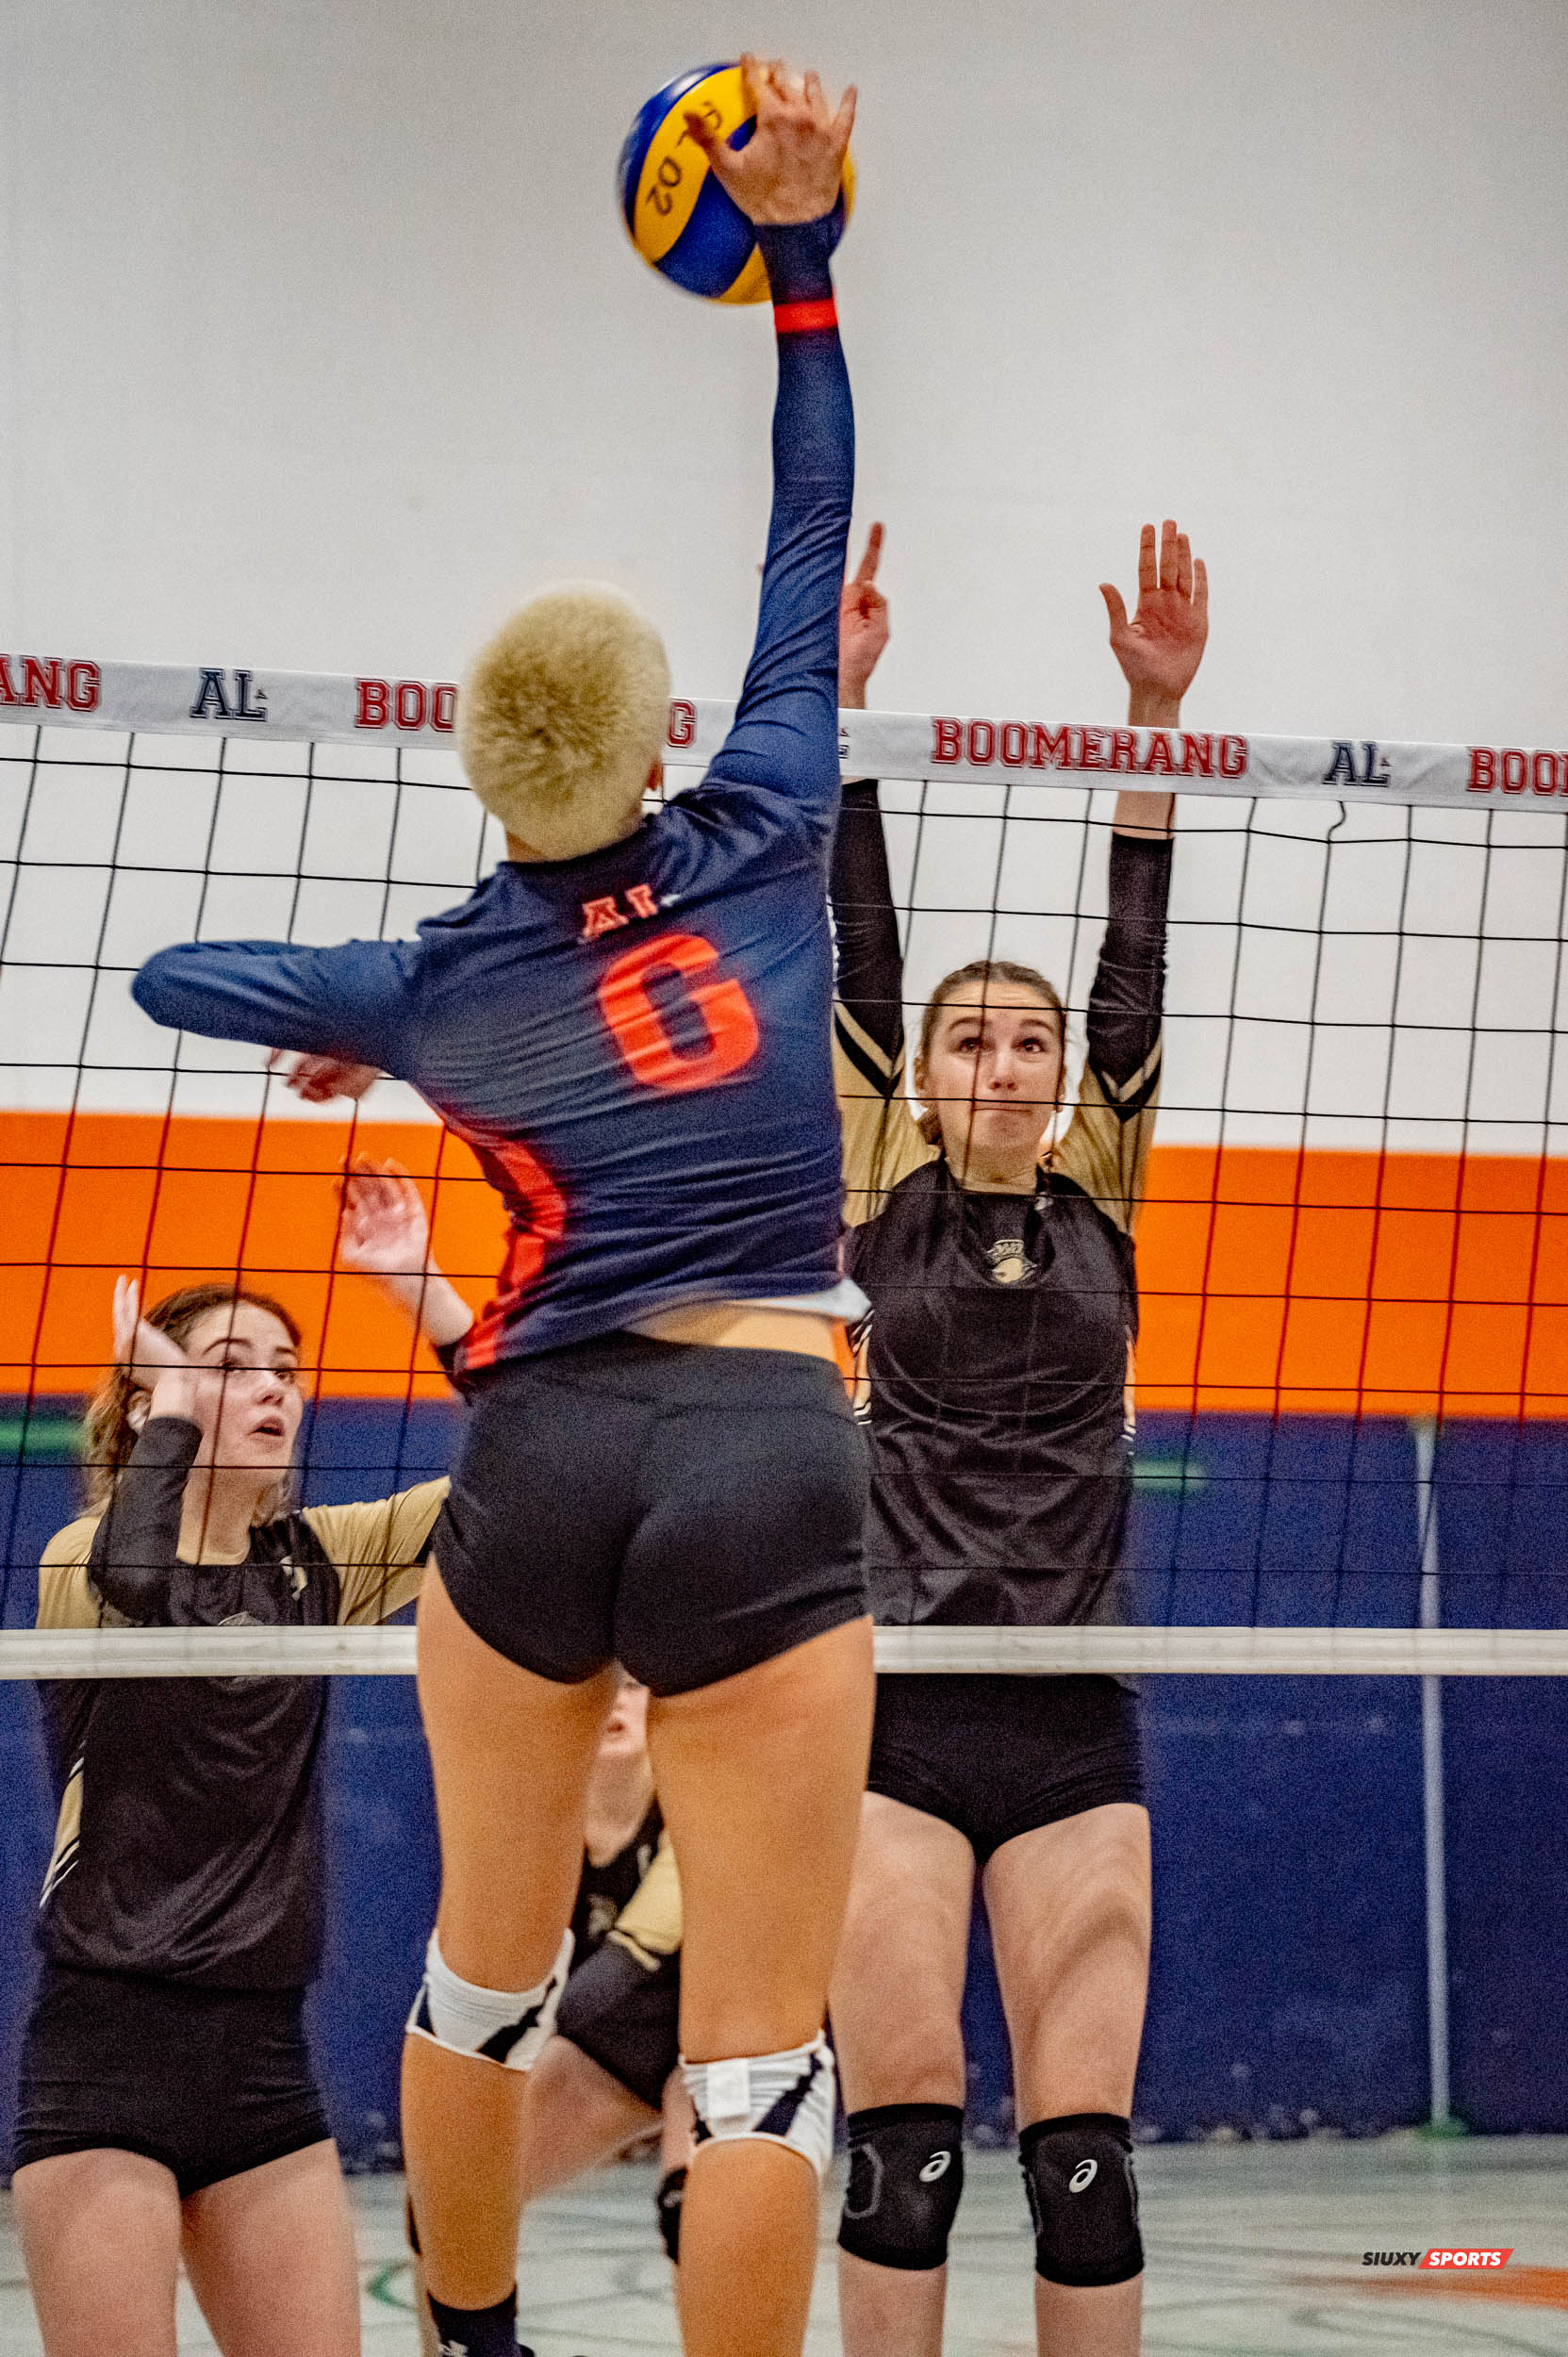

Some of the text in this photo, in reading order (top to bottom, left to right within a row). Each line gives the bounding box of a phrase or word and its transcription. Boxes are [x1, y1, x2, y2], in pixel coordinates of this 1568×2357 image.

[190, 667, 267, 722] AL
[930, 716, 1250, 780] BOOMERANG
[1322, 739, 1391, 788] AL
[1465, 746, 1568, 798] BOO
[598, 933, 760, 1090] 6
